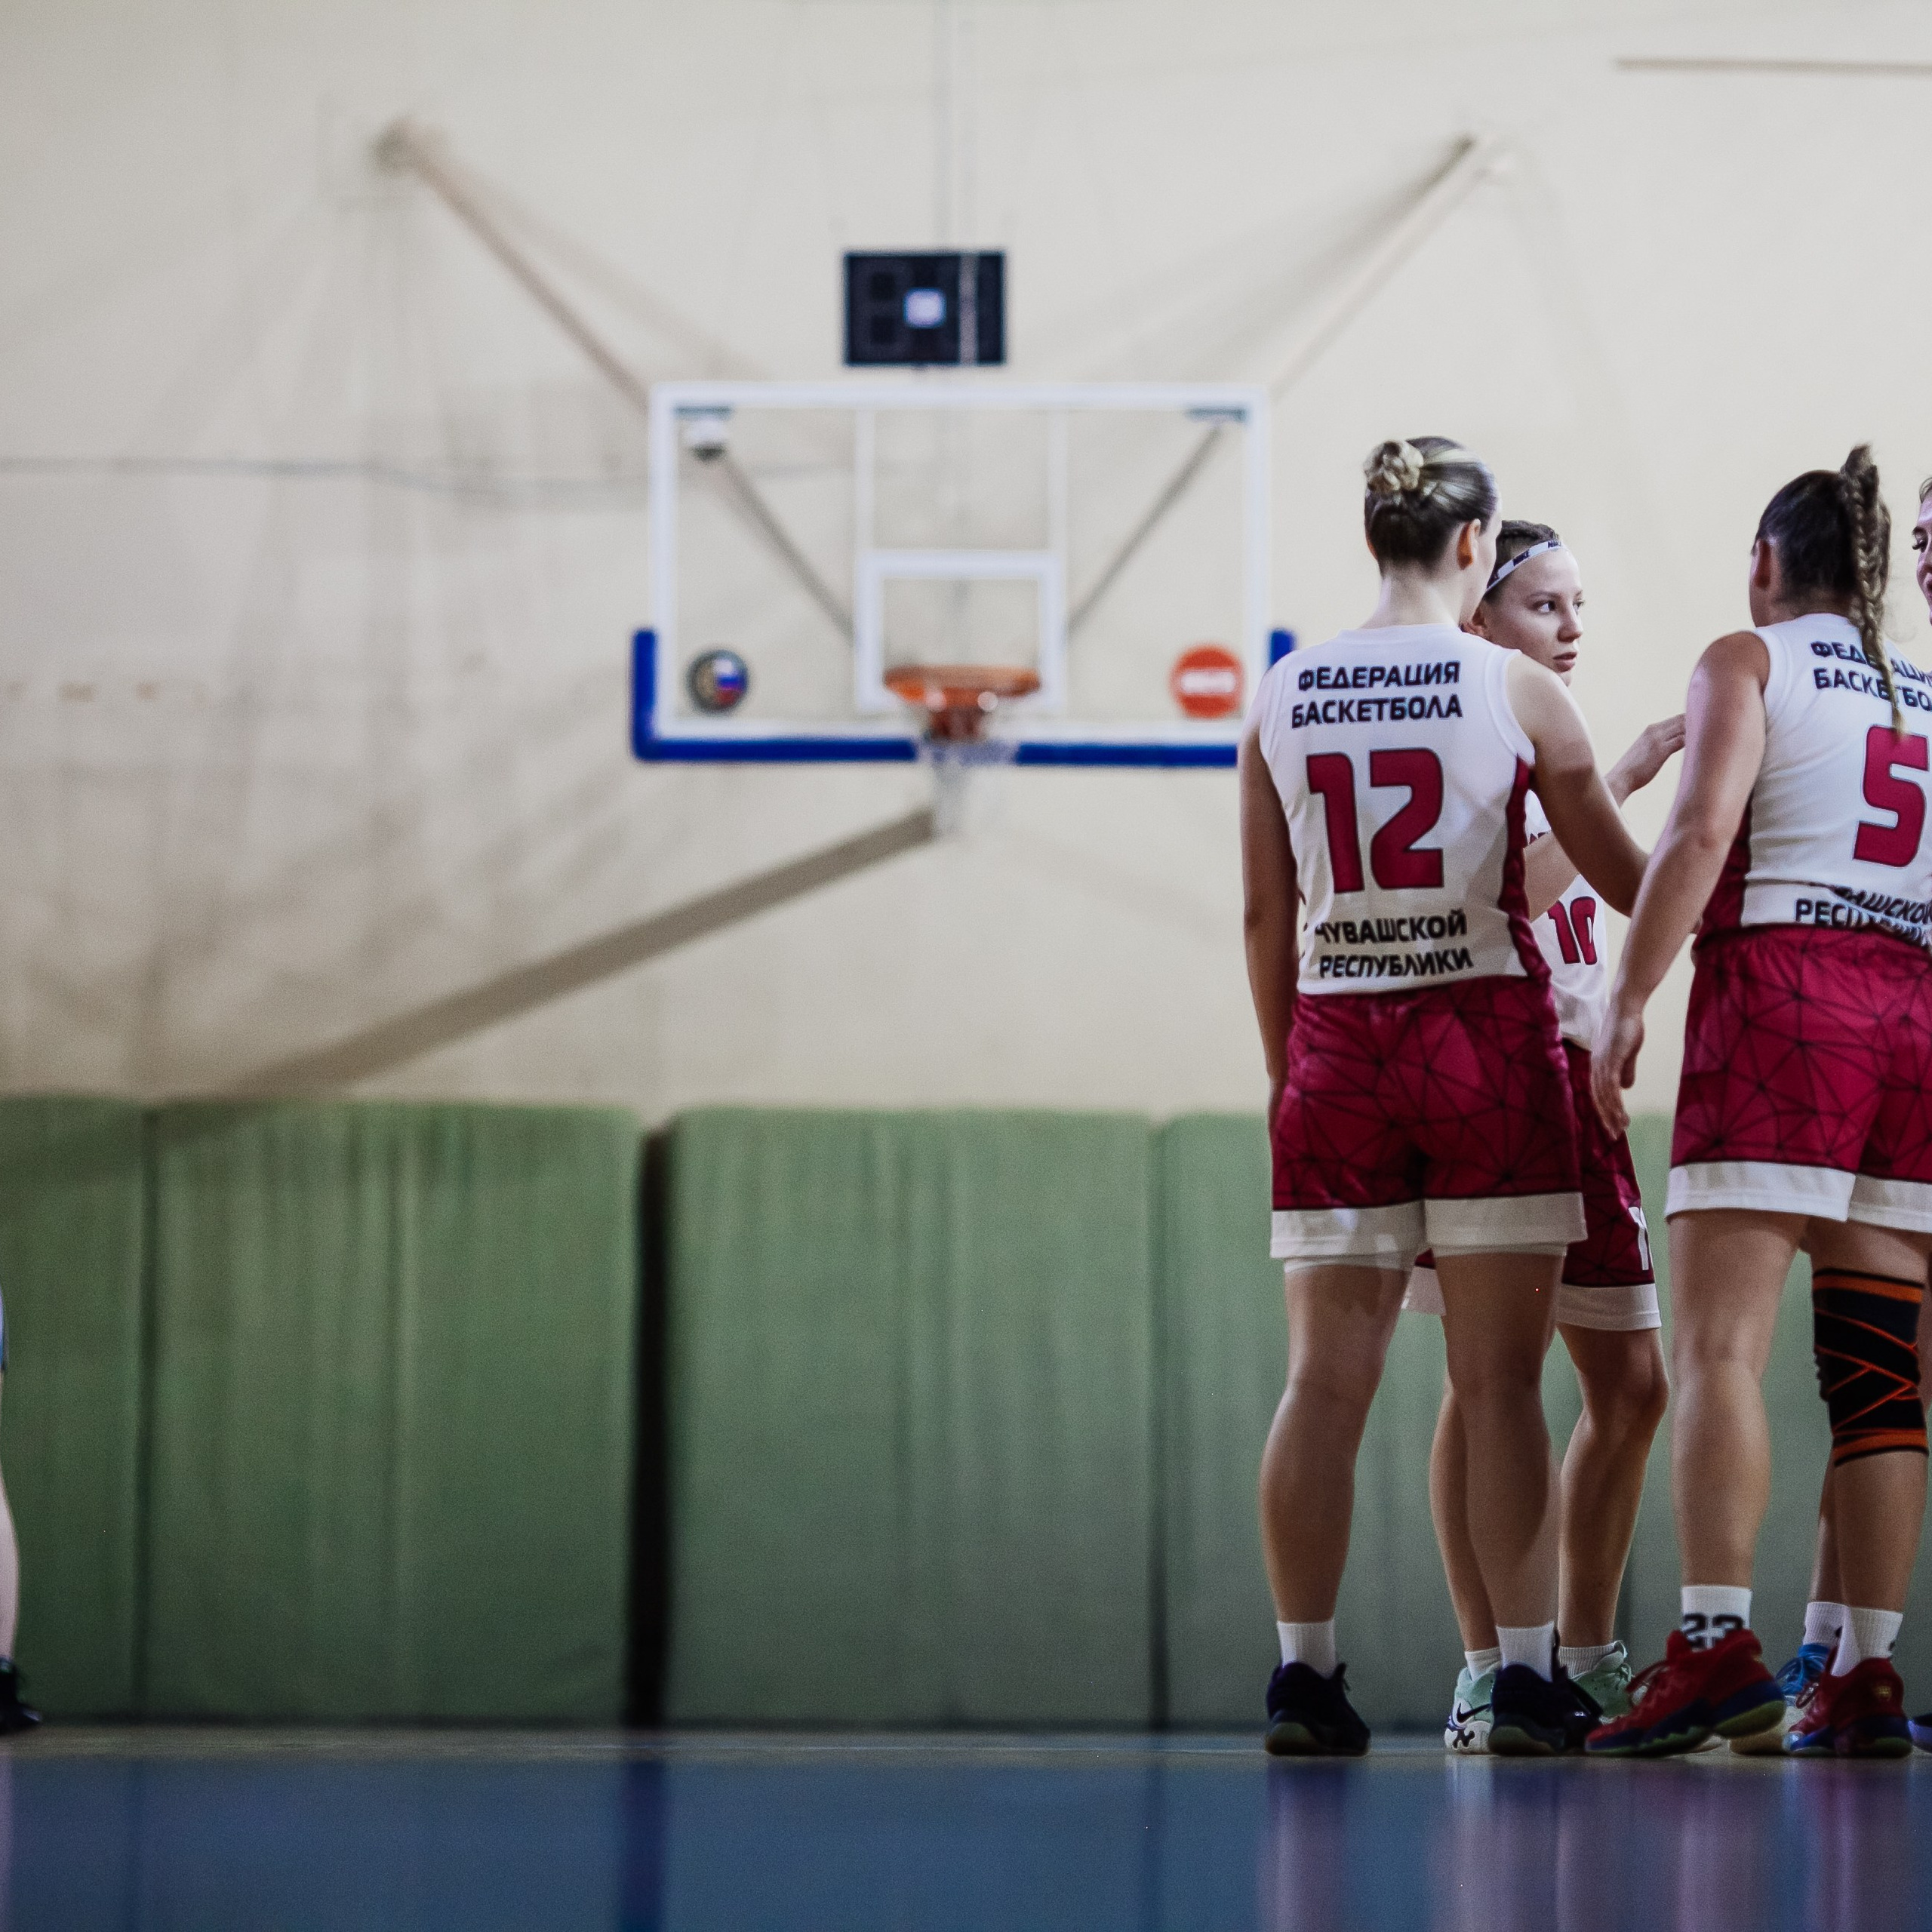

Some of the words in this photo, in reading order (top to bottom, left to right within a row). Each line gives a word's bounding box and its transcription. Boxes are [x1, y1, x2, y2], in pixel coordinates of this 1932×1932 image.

[1298, 660, 1460, 691] ФЕДЕРАЦИЯ
[1814, 667, 1932, 712] БАСКЕБО
[1291, 693, 1463, 729] БАСКЕТБОЛА
[1853, 724, 1929, 867] 5
[1306, 747, 1444, 894] 12
[1315, 908, 1468, 944] ЧУВАШСКОЙ
[1548, 896, 1598, 965] 10
[1320, 946, 1474, 979] РЕСПУБЛИКИ
